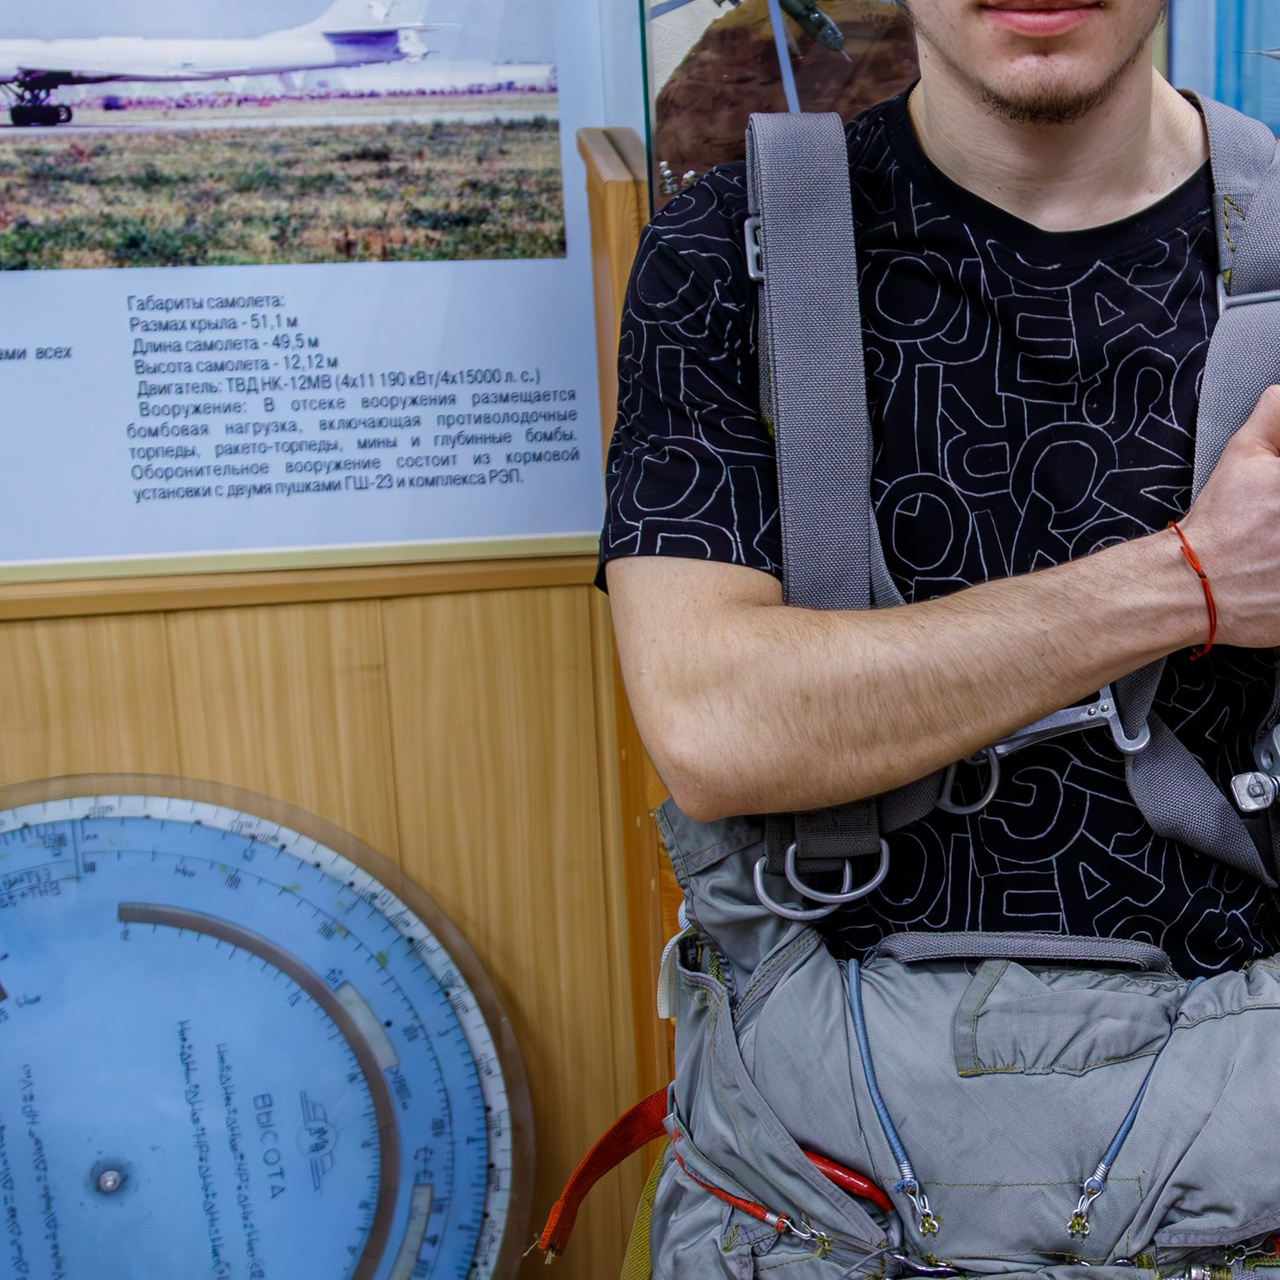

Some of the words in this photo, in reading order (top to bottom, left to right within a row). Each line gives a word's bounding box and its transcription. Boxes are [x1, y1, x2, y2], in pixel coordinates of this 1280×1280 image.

[127, 295, 203, 314] Габариты
[206, 294, 285, 310] самолета:
[129, 316, 187, 332] Размах
[190, 317, 237, 334] крыла
[250, 314, 282, 331] 51,1
[35, 346, 73, 359] всех
[132, 337, 182, 356] Длина
[185, 336, 259, 352] самолета
[271, 333, 305, 351] 49,5
[134, 359, 193, 375] Высота
[196, 358, 270, 373] самолета
[283, 354, 324, 372] 12,12
[137, 380, 223, 399] Двигатель:
[225, 377, 260, 396] ТВД
[261, 375, 332, 392] НК-12МВ
[139, 401, 248, 419] Вооружение:
[291, 397, 346, 411] отсеке
[361, 393, 456, 410] вооружения
[472, 389, 576, 407] размещается
[126, 422, 209, 439] бомбовая
[225, 419, 303, 436] нагрузка,
[319, 414, 421, 432] включающая
[436, 408, 578, 428] противолодочные
[128, 444, 201, 461] торпеды,
[214, 438, 343, 459] ракето-торпеды,
[357, 436, 397, 449] мины
[433, 429, 512, 449] глубинные
[131, 461, 269, 482] Оборонительное
[285, 457, 381, 476] вооружение
[396, 453, 458, 469] состоит
[506, 445, 579, 465] кормовой
[133, 483, 211, 504] установки
[226, 480, 272, 499] двумя
[275, 477, 341, 497] пушками
[344, 473, 392, 491] ГШ-23
[408, 470, 487, 487] комплекса
[488, 467, 524, 484] РЭП.
